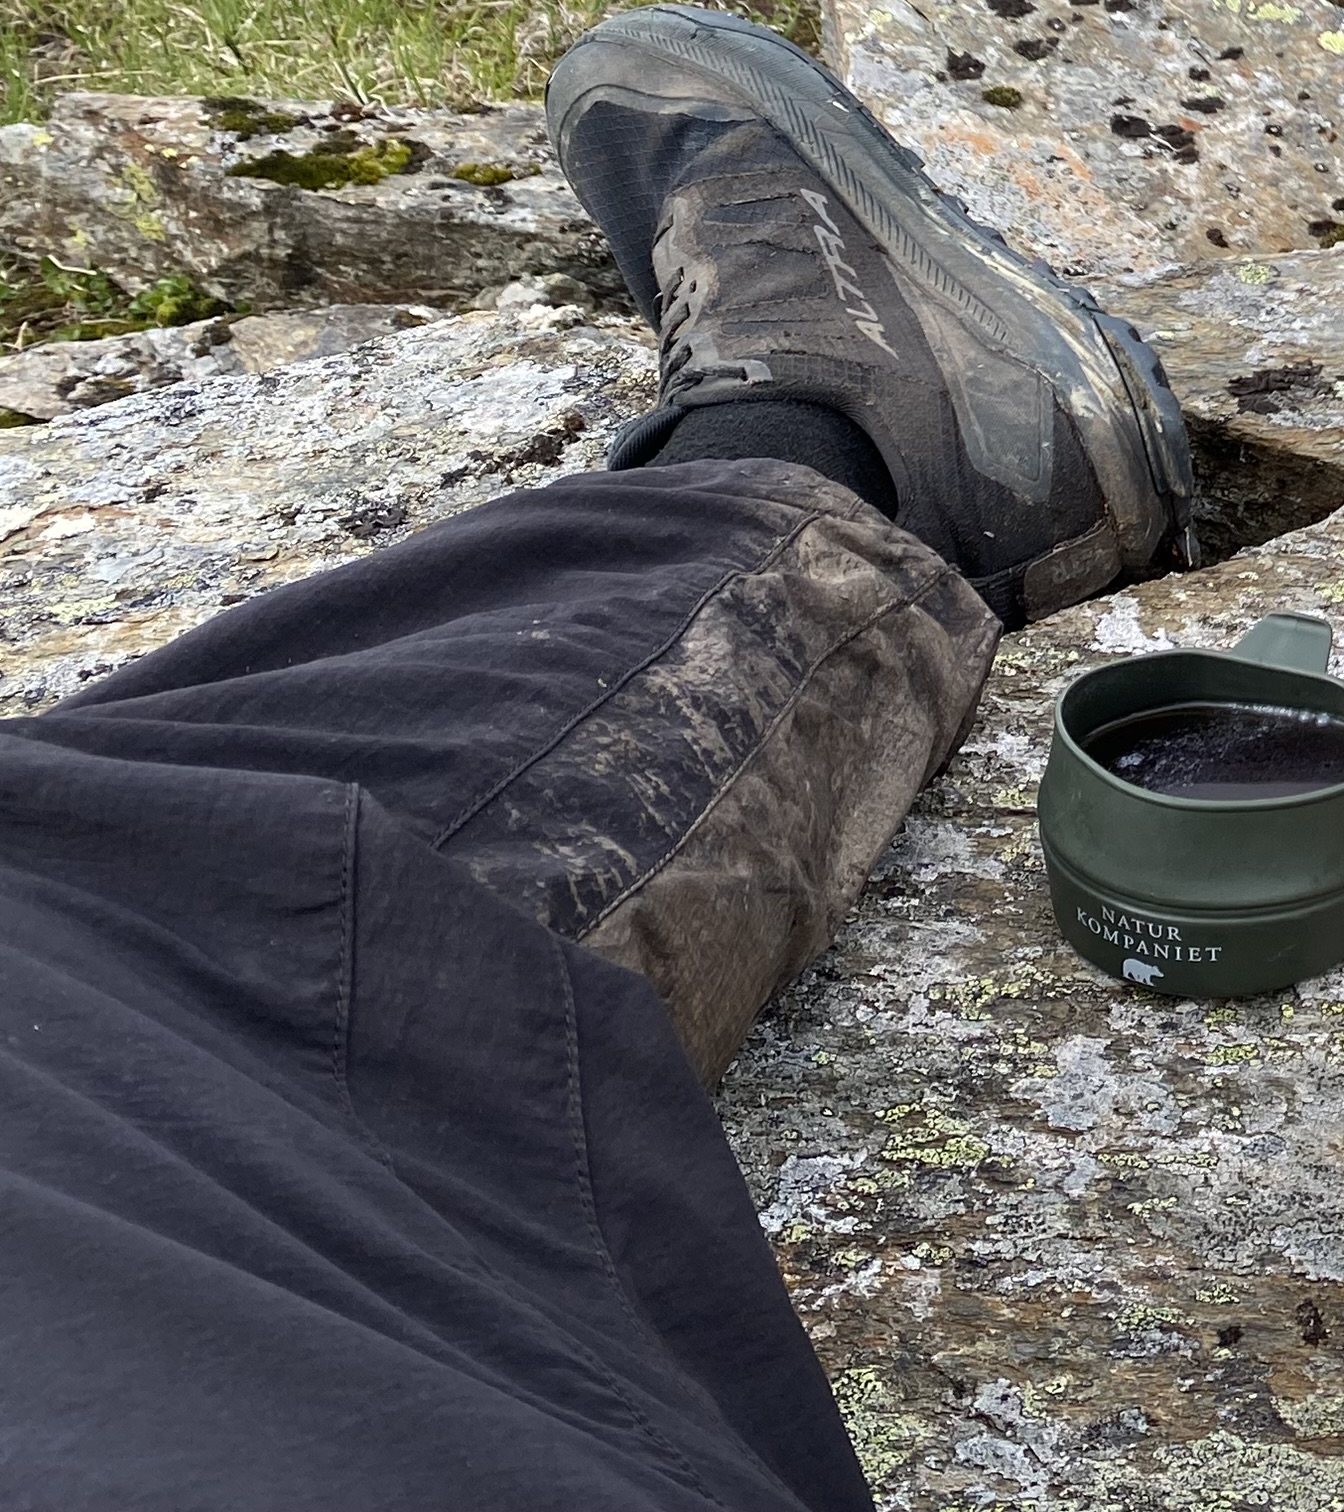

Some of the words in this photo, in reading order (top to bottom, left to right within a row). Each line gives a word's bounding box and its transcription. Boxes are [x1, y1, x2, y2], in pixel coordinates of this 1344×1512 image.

[800, 188, 899, 360] ALTRA
[1076, 906, 1222, 962] KOMPANIET
[1101, 905, 1182, 941] NATUR
